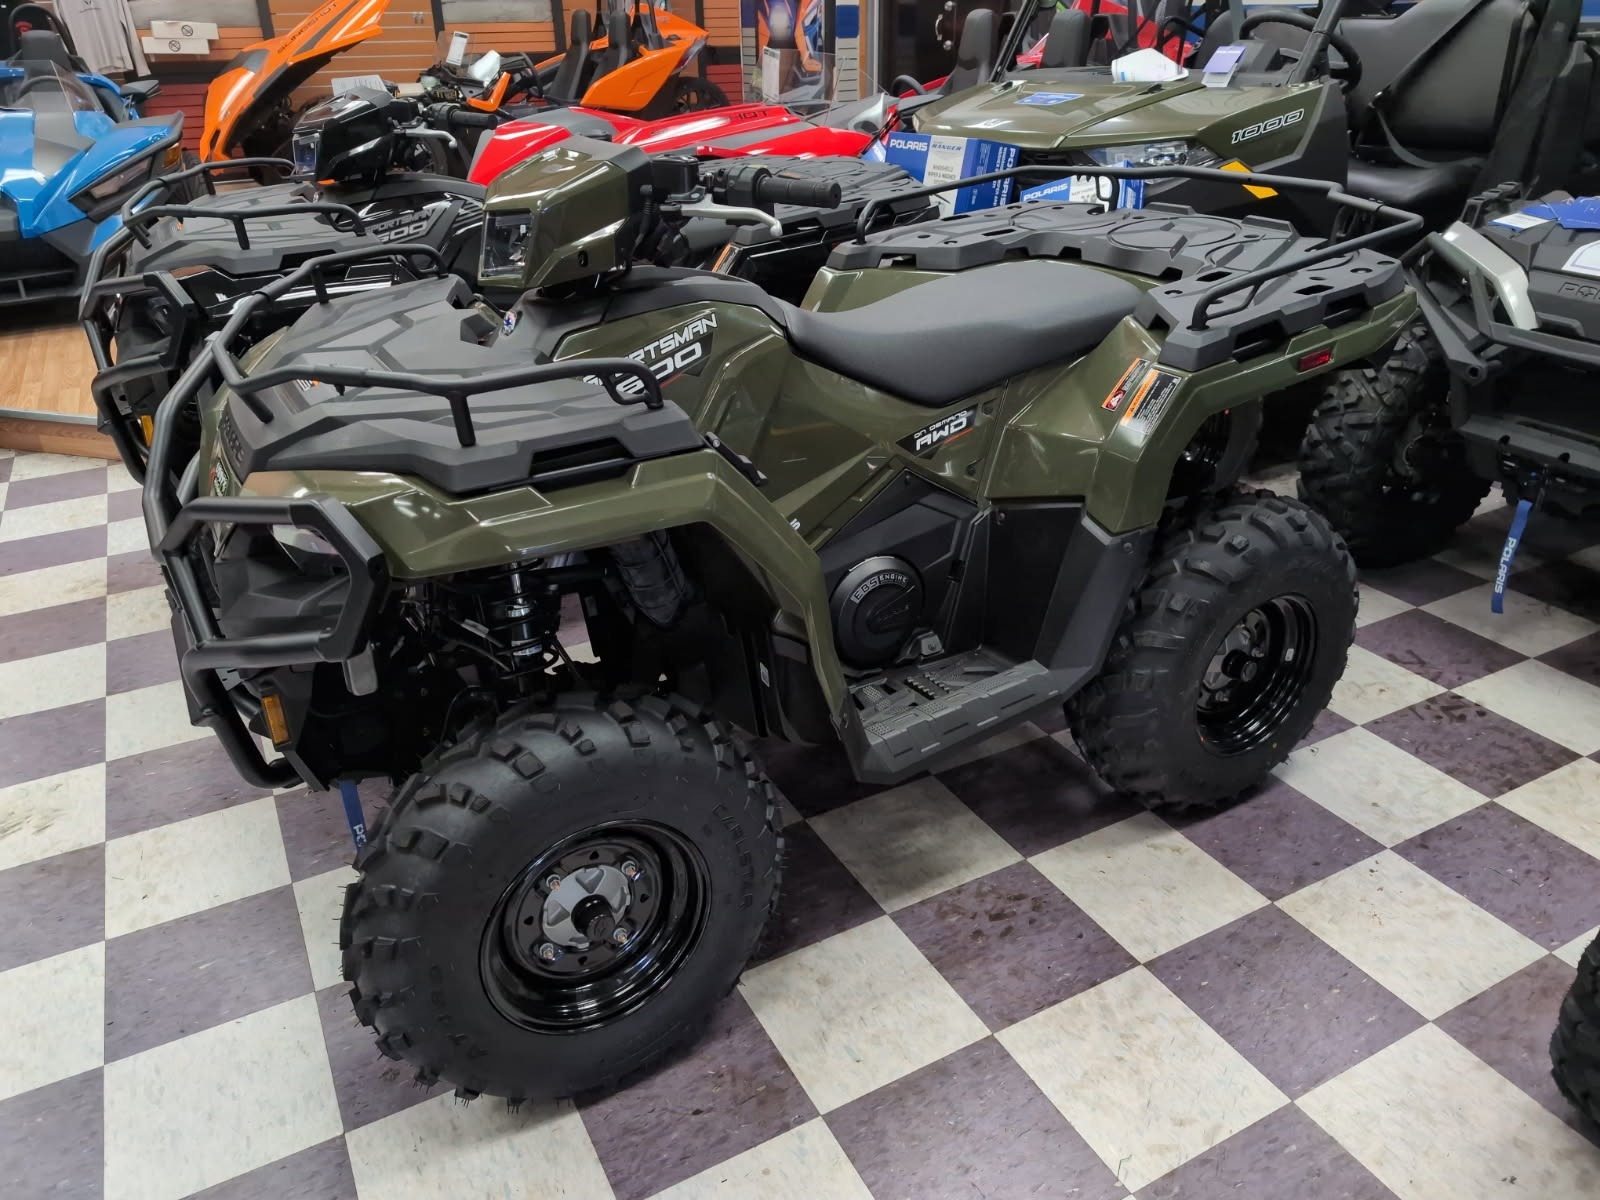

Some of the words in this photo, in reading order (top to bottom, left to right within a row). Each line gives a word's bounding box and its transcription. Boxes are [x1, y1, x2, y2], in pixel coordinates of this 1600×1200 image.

[1231, 108, 1305, 145] 1000
[889, 138, 928, 152] POLARIS
[1000, 147, 1016, 206] POARIS
[1023, 183, 1069, 202] POLARIS
[913, 429, 927, 439] ON
[915, 417, 967, 451] AWD
[1494, 536, 1517, 594] POLARIS
[852, 577, 879, 602] EBS
